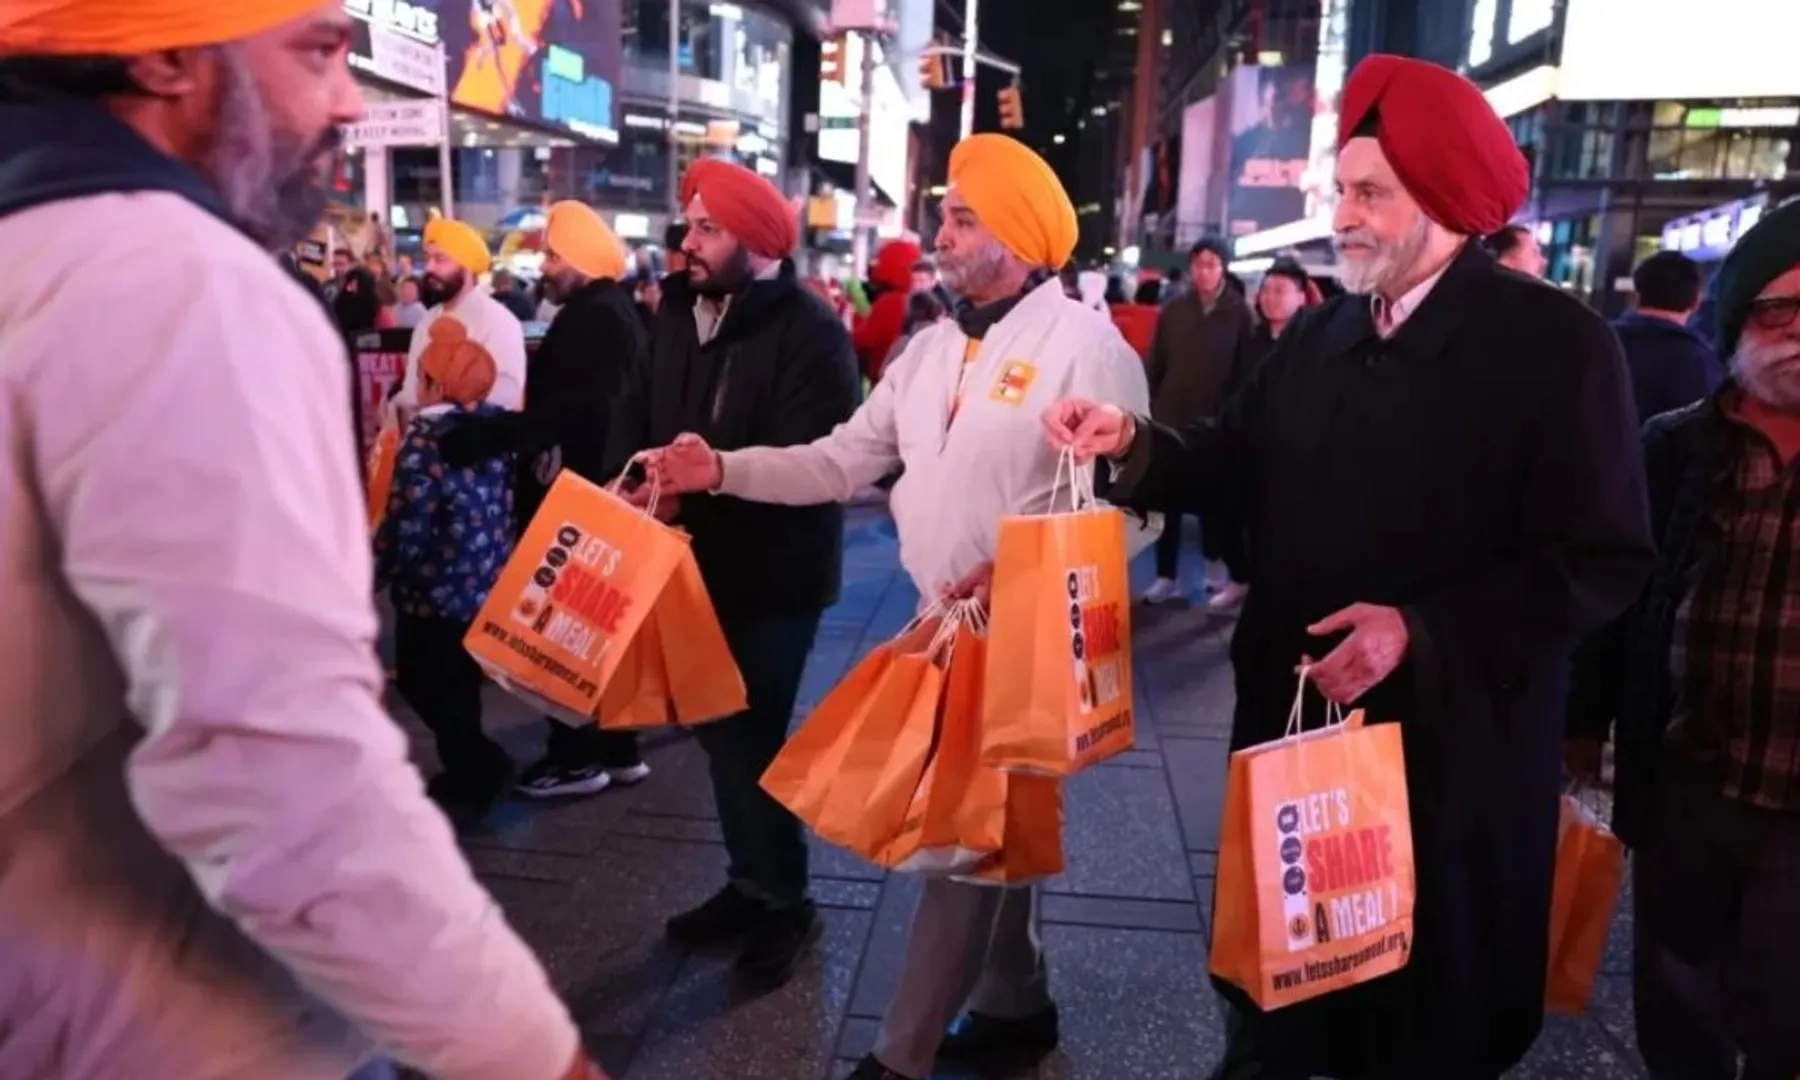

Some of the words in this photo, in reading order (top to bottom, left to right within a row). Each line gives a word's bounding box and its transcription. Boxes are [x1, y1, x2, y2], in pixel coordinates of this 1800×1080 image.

[572, 533, 622, 577] LET'S
[552, 563, 633, 634] SHARE
[532, 604, 553, 635] A
[543, 611, 596, 661] MEAL
[1300, 789, 1349, 834] LET'S
[1307, 826, 1395, 893] SHARE
[1314, 902, 1330, 944] A
[1331, 889, 1386, 939] MEAL
